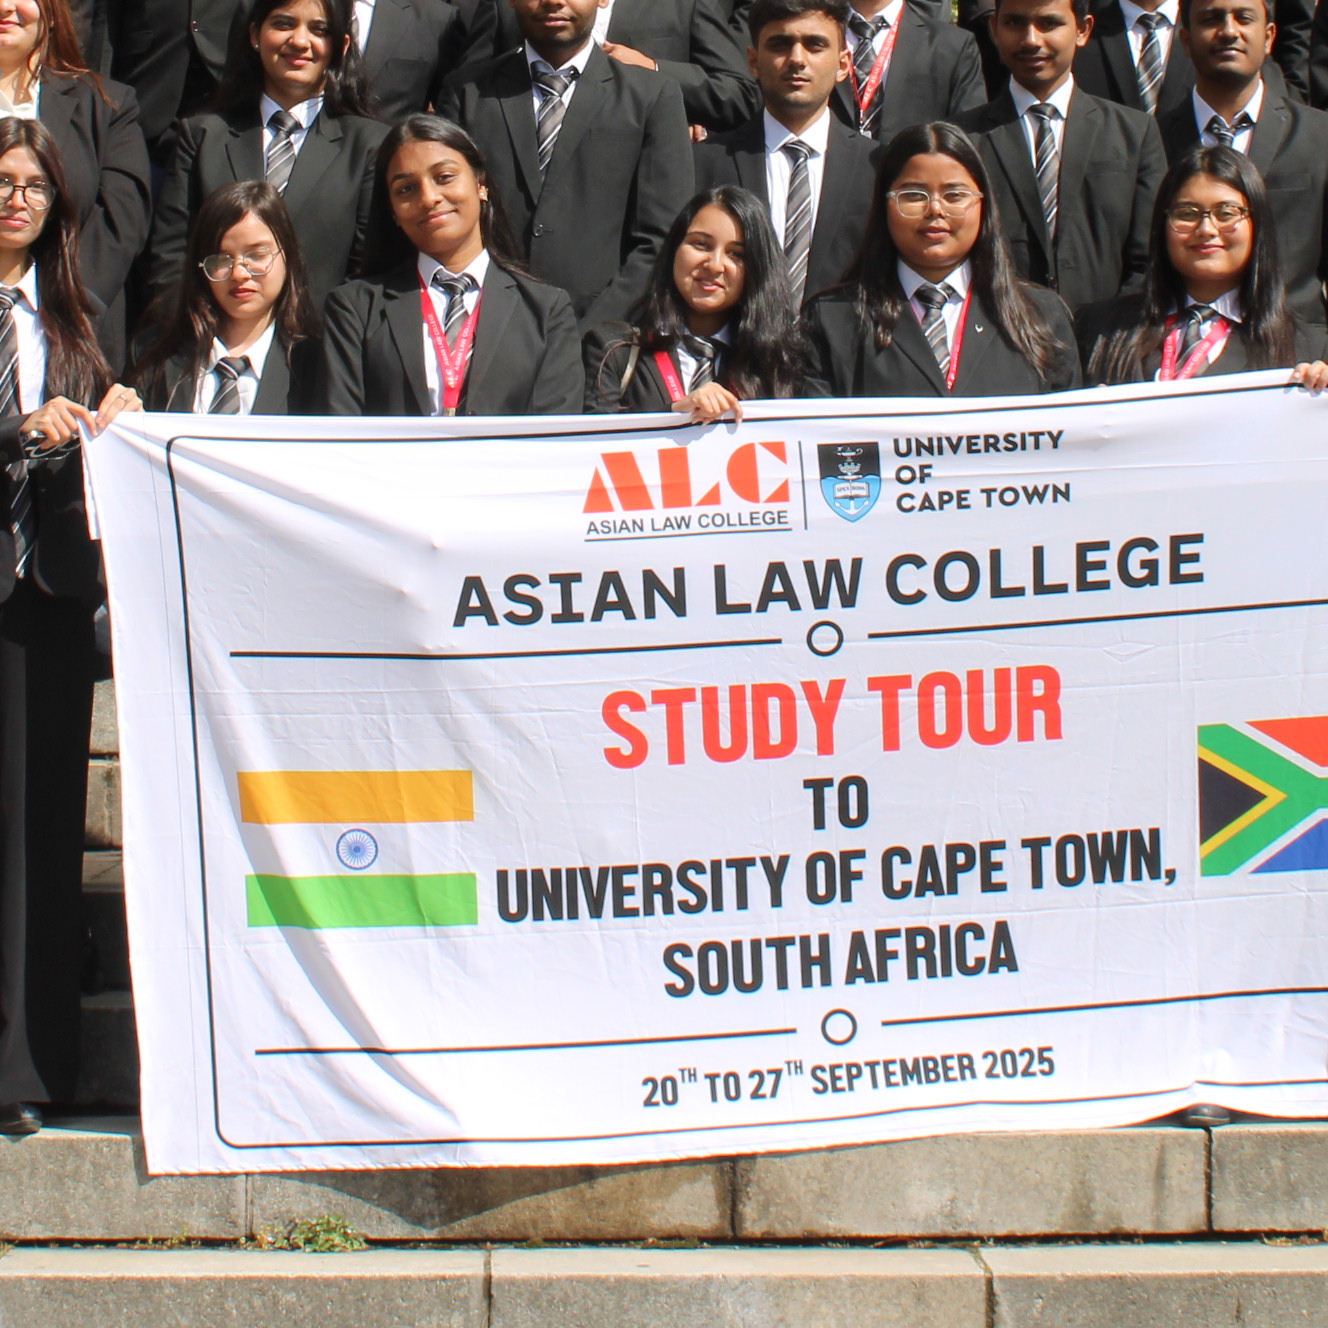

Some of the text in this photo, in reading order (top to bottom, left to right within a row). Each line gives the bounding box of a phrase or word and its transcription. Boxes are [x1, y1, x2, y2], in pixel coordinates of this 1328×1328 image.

[455, 354, 464, 371] ASIAN
[459, 339, 468, 355] LAW
[894, 431, 1064, 457] UNIVERSITY
[583, 441, 790, 513] ALC
[895, 464, 933, 484] OF
[897, 483, 1070, 512] CAPE TOWN
[587, 510, 789, 535] ASIAN LAW COLLEGE
[453, 534, 1204, 627] ASIAN LAW COLLEGE
[602, 665, 1063, 768] STUDY TOUR
[803, 776, 869, 830] TO
[497, 828, 1176, 922] UNIVERSITY OF CAPE TOWN,
[663, 921, 1019, 998] SOUTH AFRICA
[705, 1072, 741, 1102] TO
[812, 1053, 976, 1093] SEPTEMBER
[983, 1046, 1054, 1078] 2025
